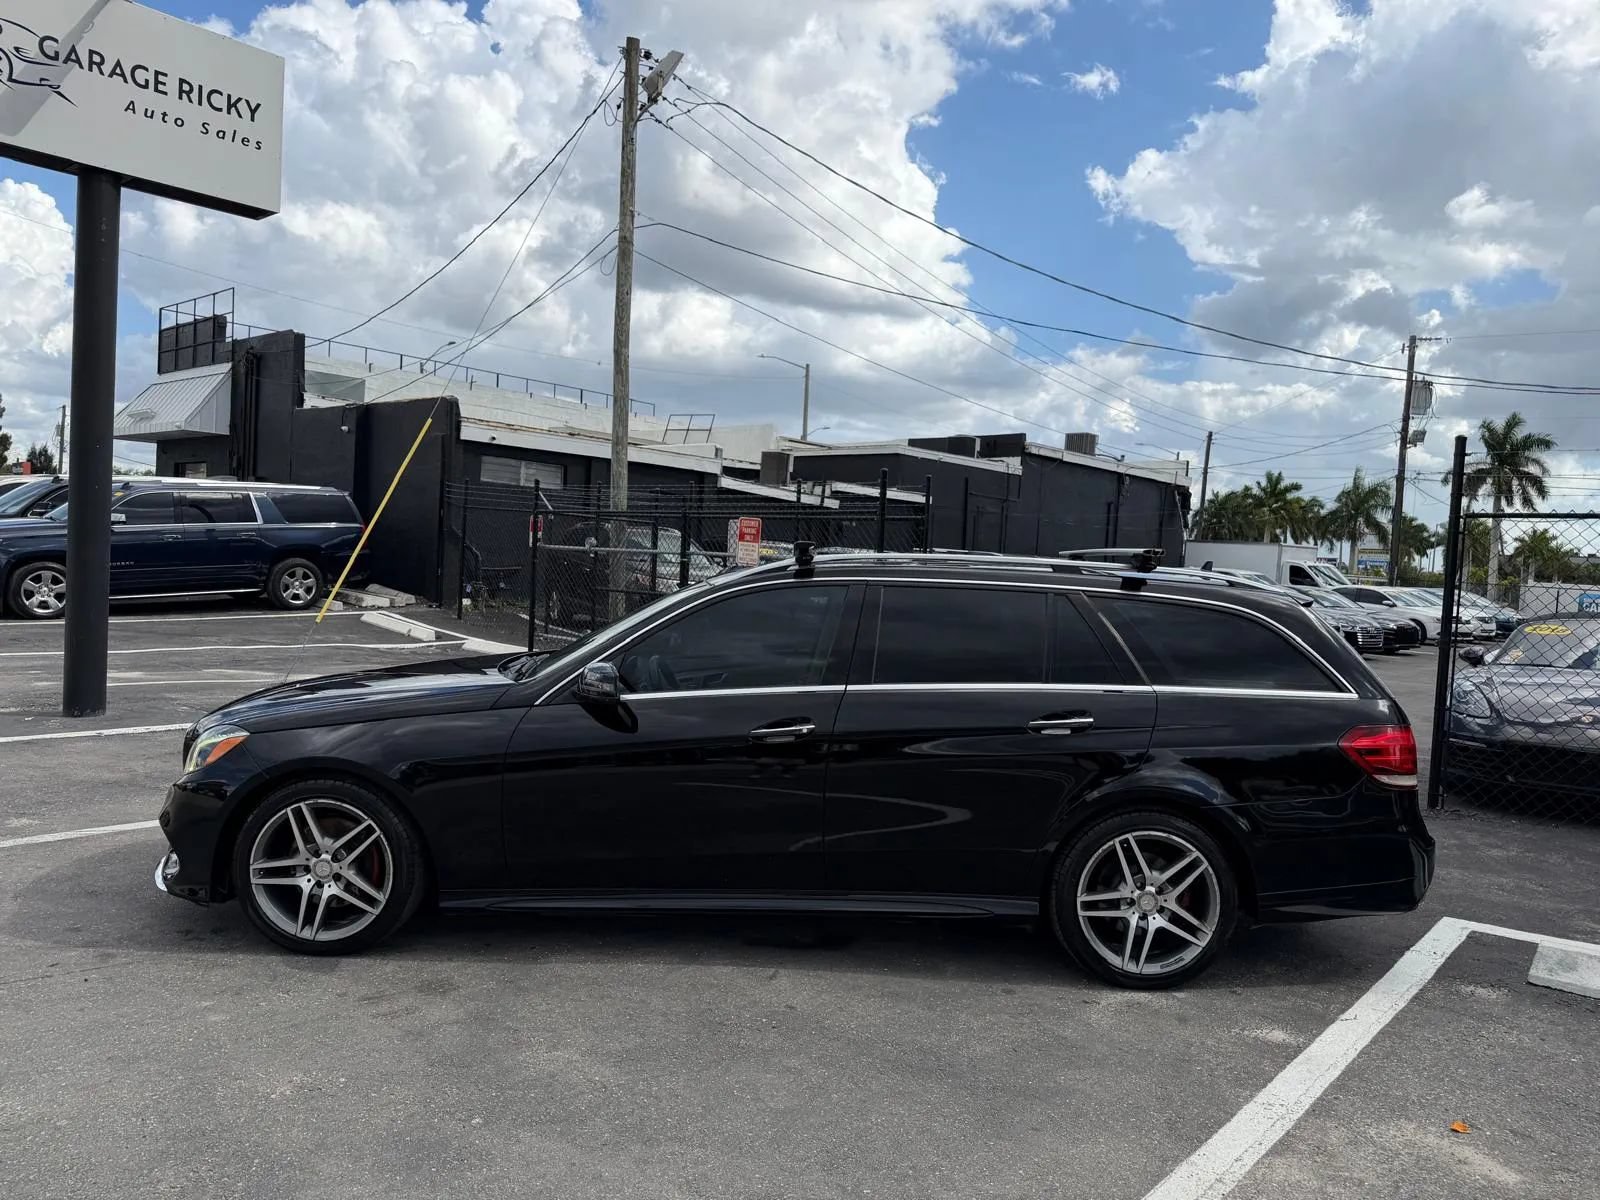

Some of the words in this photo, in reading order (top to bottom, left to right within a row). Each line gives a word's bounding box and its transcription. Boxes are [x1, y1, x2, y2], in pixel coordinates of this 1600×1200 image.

[38, 35, 169, 96] GARAGE
[178, 77, 262, 122] RICKY
[124, 100, 185, 128] Auto
[200, 122, 263, 150] Sales
